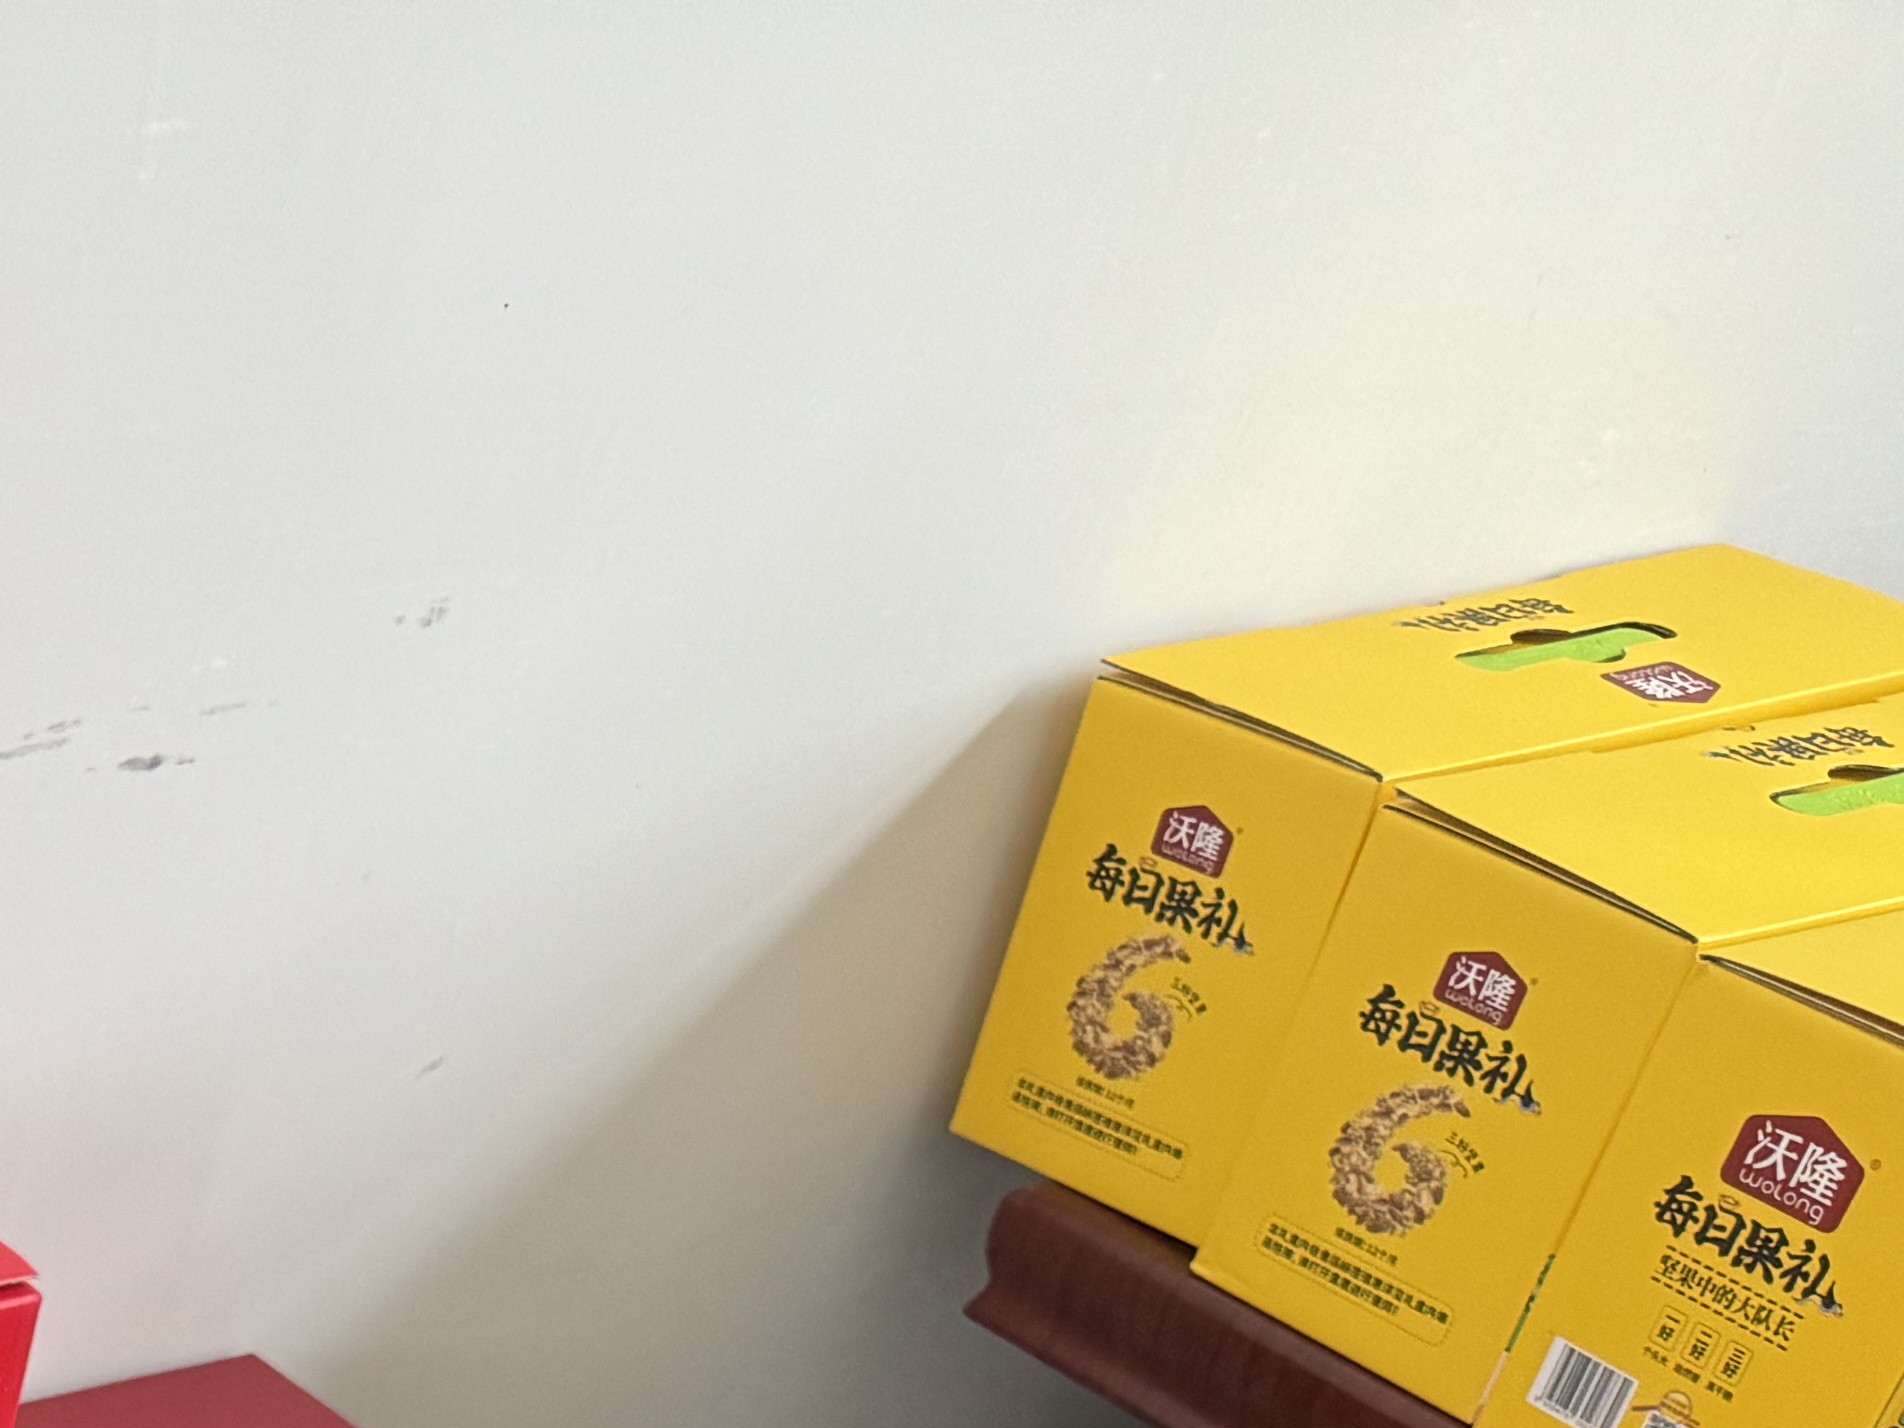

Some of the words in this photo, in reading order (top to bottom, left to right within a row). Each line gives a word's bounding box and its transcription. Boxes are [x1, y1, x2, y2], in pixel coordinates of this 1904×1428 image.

[1163, 810, 1225, 862] 沃隆
[1086, 844, 1255, 955] 每日果礼
[1447, 957, 1517, 1012] 沃隆
[1359, 984, 1541, 1115] 每日果礼
[1744, 1121, 1845, 1207] 沃隆
[1654, 1175, 1844, 1318] 每日果礼
[1659, 1255, 1796, 1342] 坚果中的大队长
